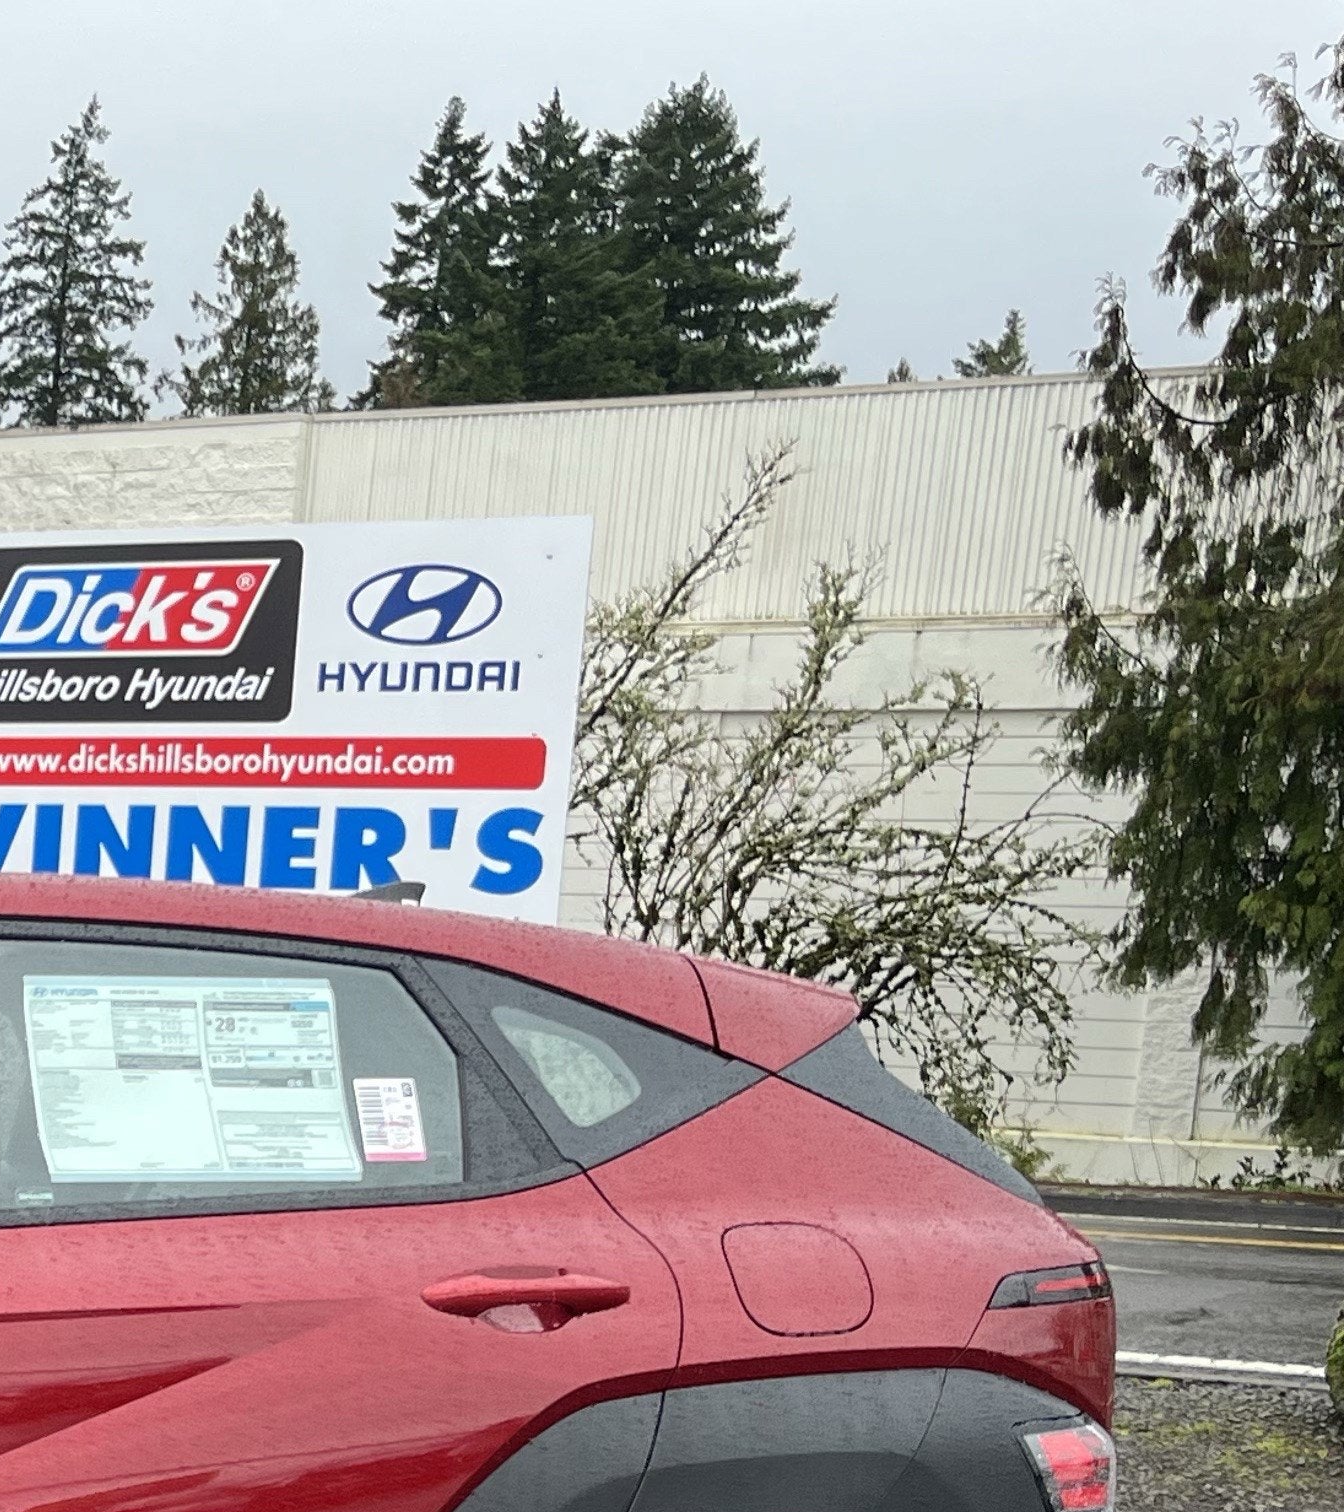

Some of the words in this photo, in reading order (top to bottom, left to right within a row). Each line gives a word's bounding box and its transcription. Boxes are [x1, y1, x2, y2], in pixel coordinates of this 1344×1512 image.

[123, 667, 275, 710] Hyundai
[316, 659, 521, 693] HYUNDAI
[214, 1016, 237, 1033] 28
